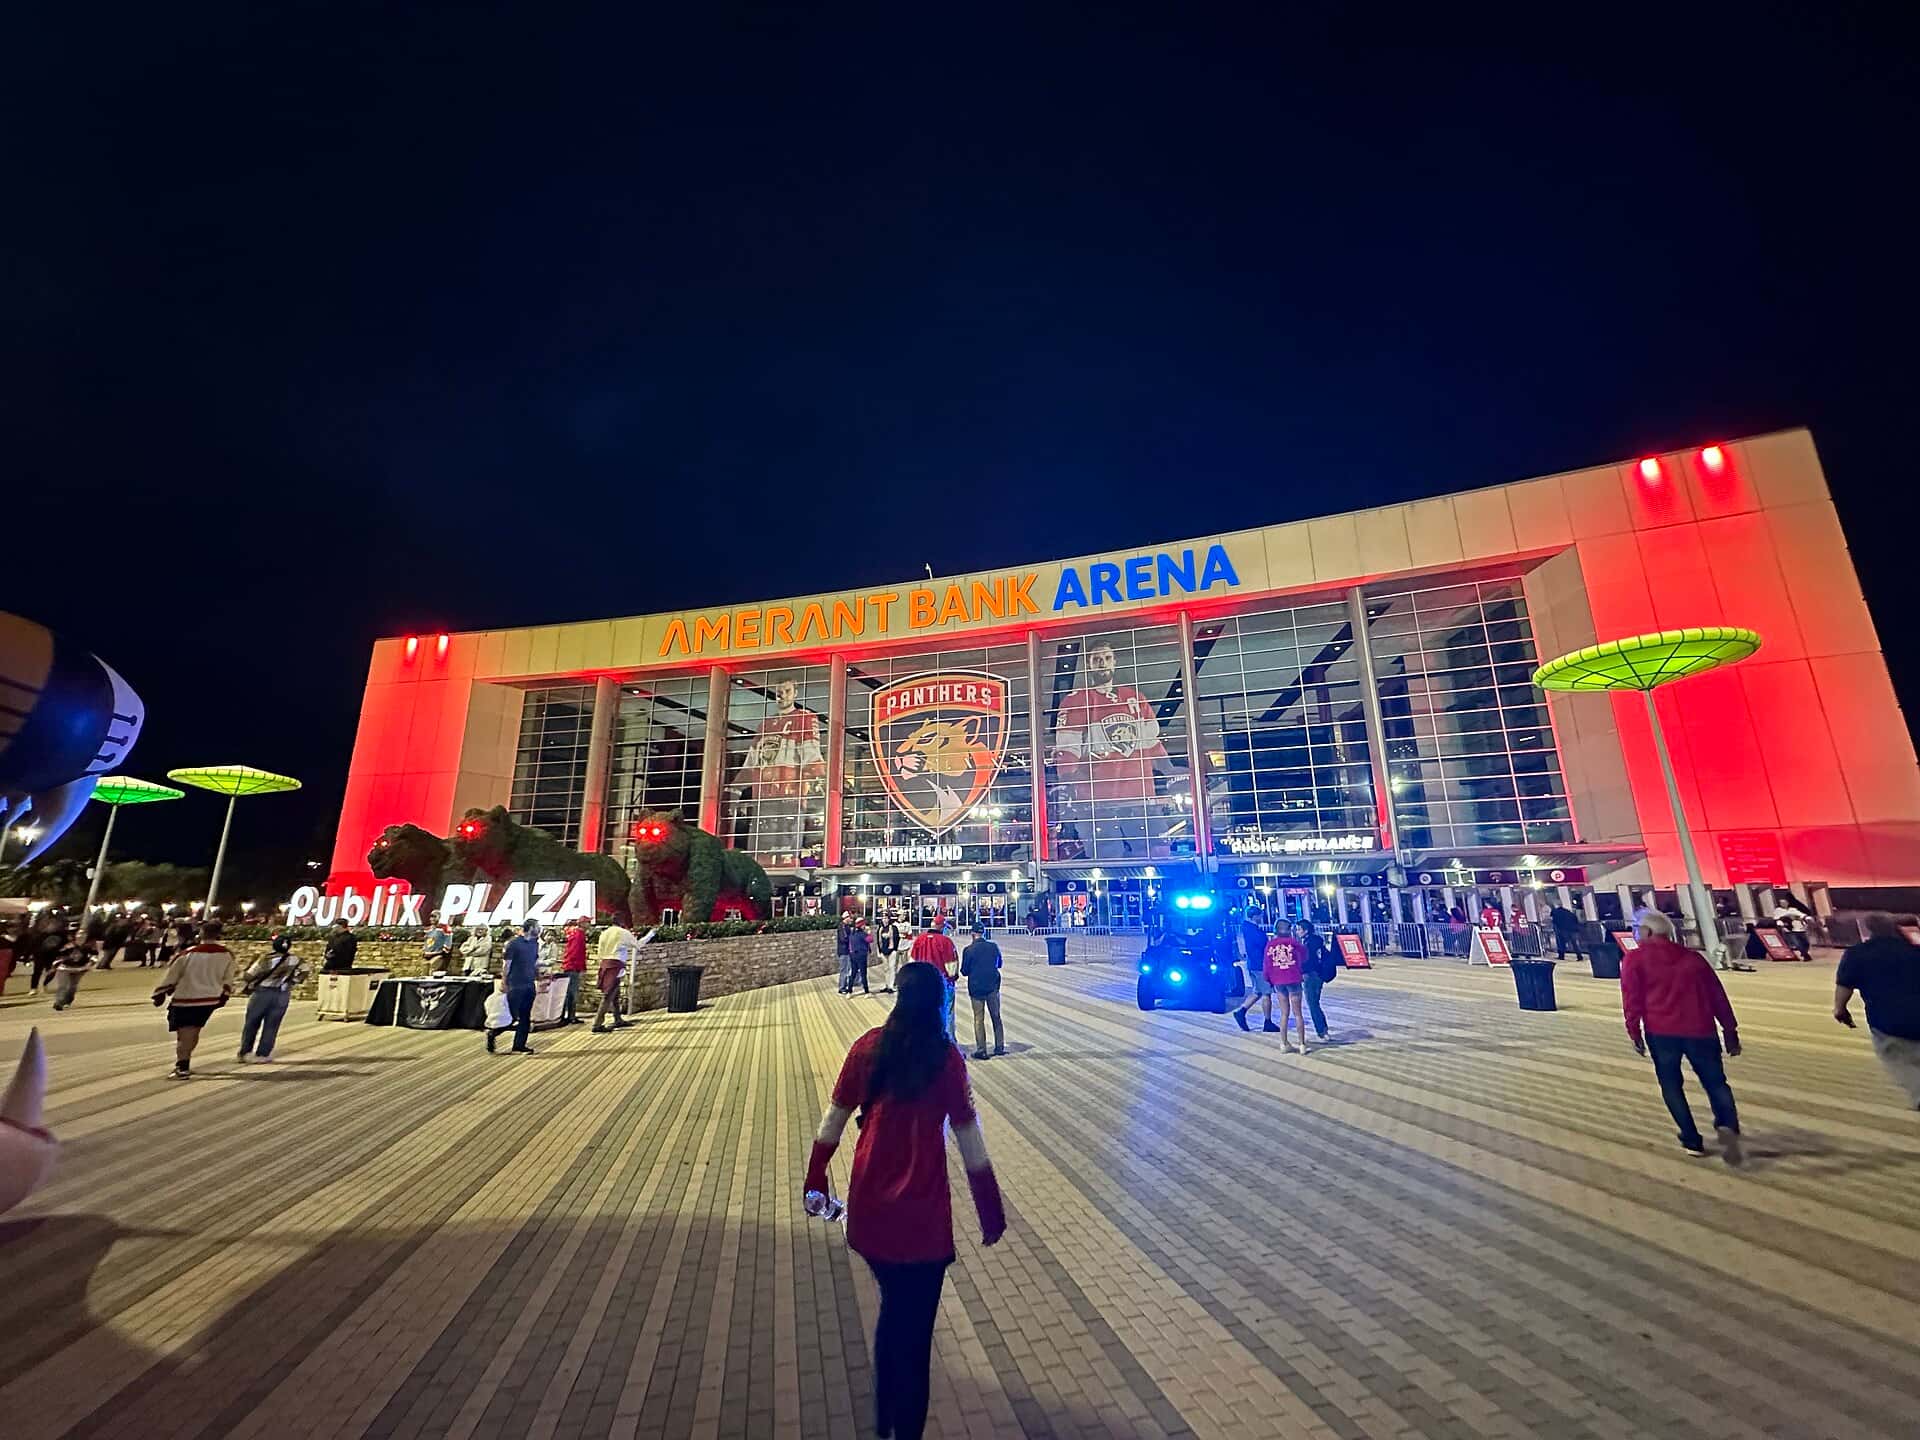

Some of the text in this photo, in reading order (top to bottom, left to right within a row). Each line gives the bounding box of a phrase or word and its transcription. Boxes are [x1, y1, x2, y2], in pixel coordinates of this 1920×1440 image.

[658, 544, 1240, 656] AMERANT BANK ARENA
[886, 684, 993, 716] PANTHERS
[864, 845, 963, 863] PANTHERLAND
[1284, 835, 1375, 852] ENTRANCE
[286, 880, 597, 927] Publix PLAZA
